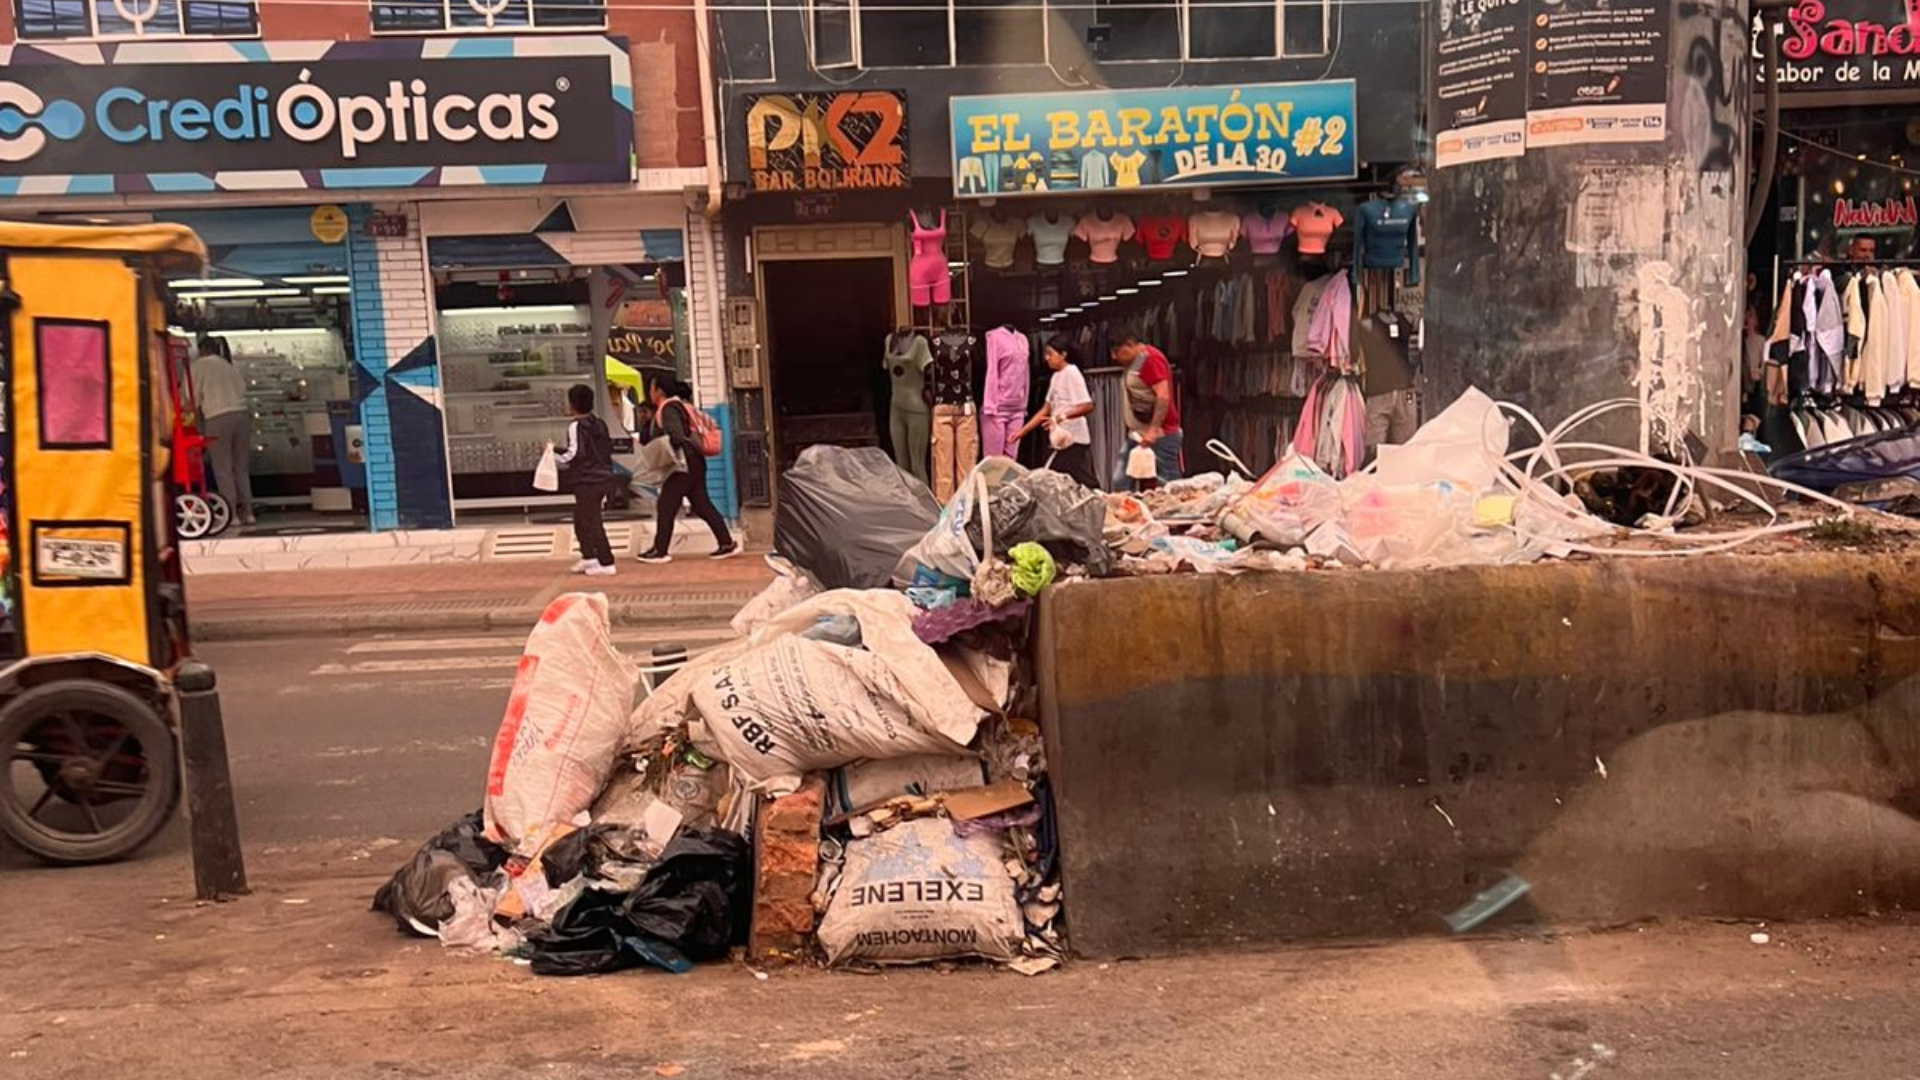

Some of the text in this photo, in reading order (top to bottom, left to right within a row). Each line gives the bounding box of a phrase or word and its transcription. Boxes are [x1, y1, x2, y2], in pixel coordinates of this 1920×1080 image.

[1835, 60, 1861, 82] de
[1873, 60, 1891, 81] la
[967, 88, 1346, 157] EL BARATÓN #2
[1174, 142, 1288, 175] DE LA 30
[755, 170, 797, 191] BAR
[731, 714, 776, 755] RBF
[851, 880, 984, 907] EXELENE
[855, 928, 977, 947] MONTACHEM
